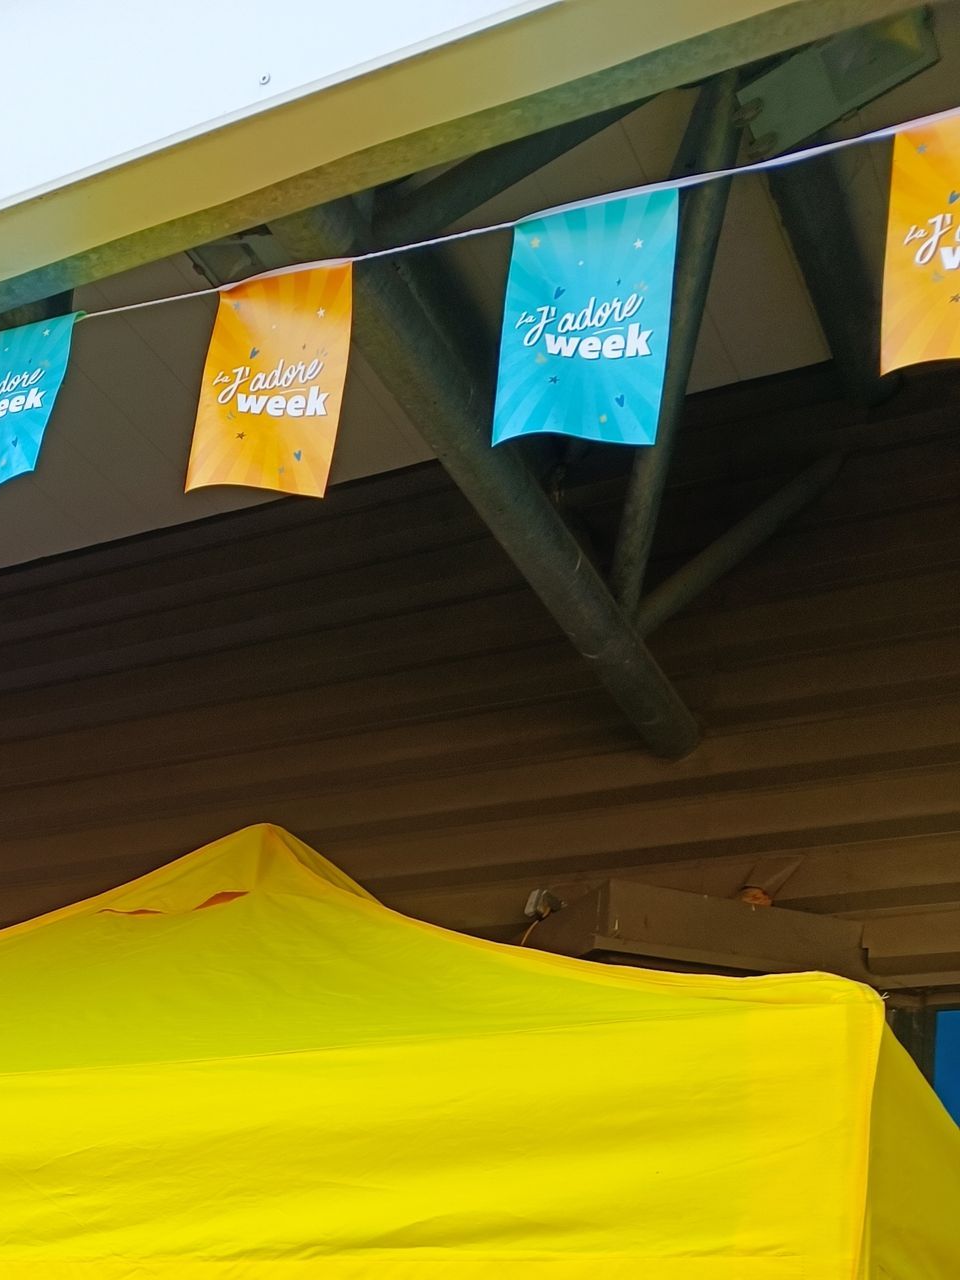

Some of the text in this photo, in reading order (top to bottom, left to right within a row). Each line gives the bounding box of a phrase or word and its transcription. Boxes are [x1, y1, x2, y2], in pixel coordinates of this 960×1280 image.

[523, 292, 644, 347] J'adore
[544, 322, 654, 360] week
[218, 358, 323, 404] J'adore
[236, 385, 329, 417] week
